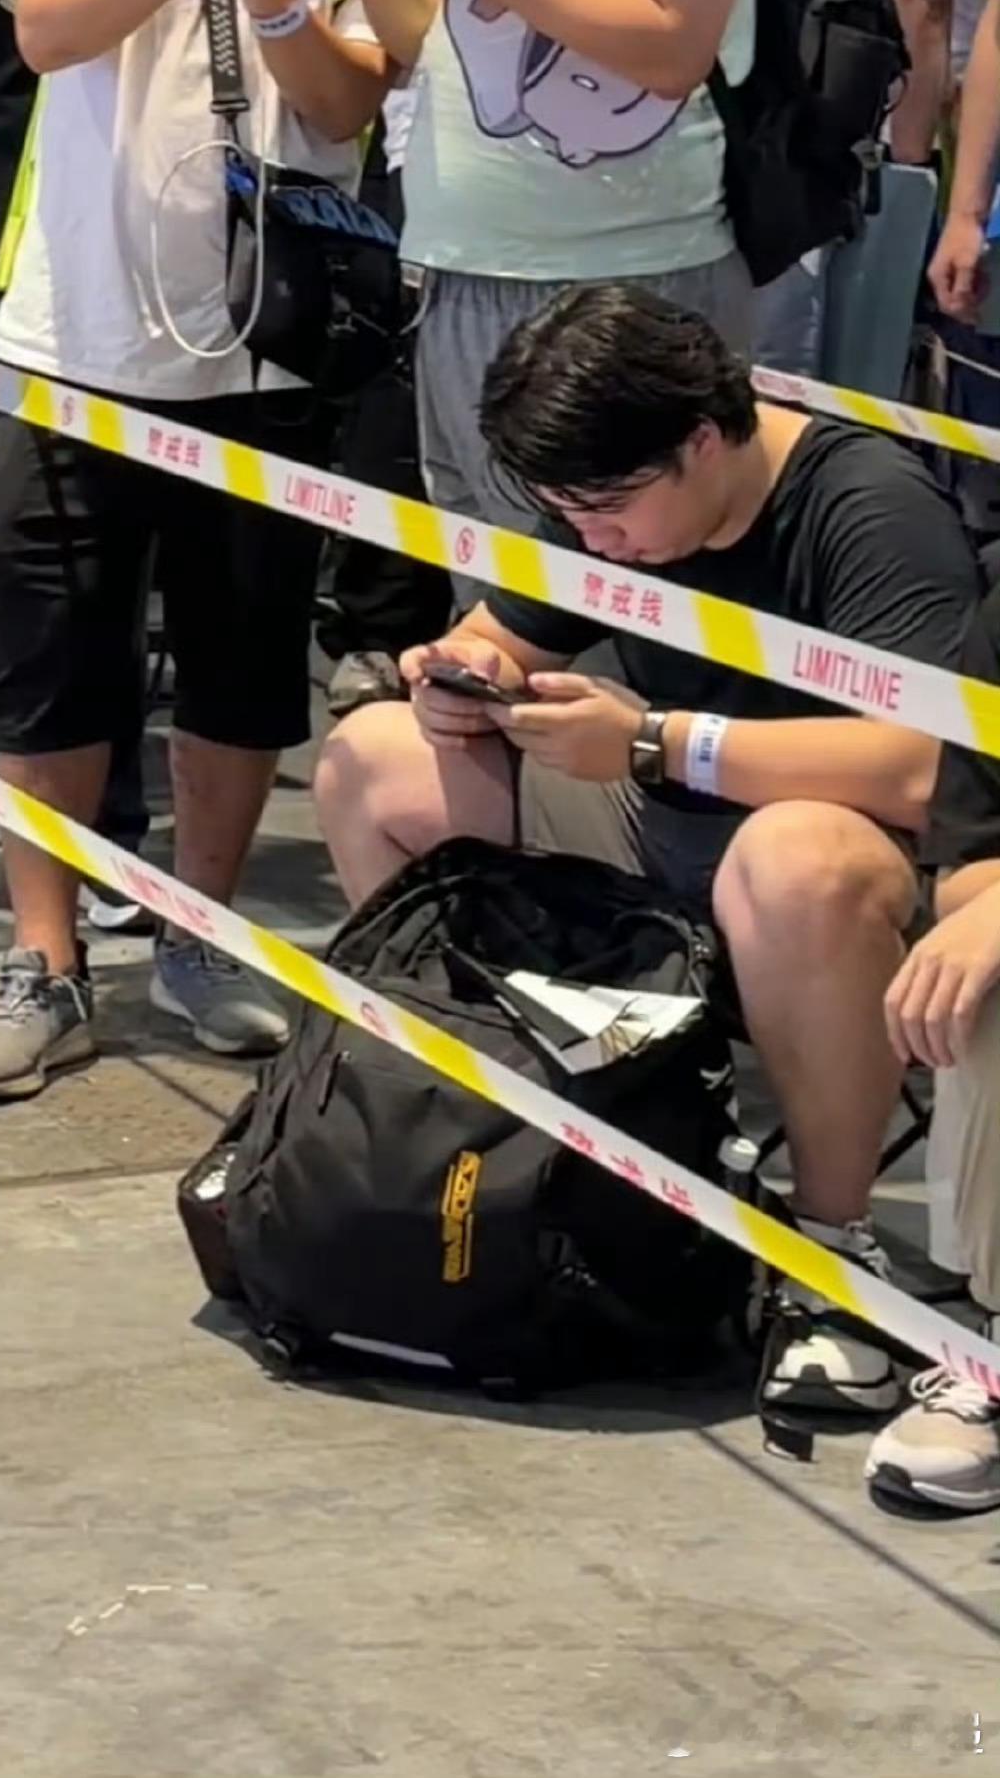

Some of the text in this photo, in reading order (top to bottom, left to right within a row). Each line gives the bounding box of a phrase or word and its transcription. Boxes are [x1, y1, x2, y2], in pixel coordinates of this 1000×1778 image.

[284, 473, 358, 527] LIMITLINE
[580, 571, 664, 628] 警戒线
[792, 640, 903, 710] LIMITLINE
